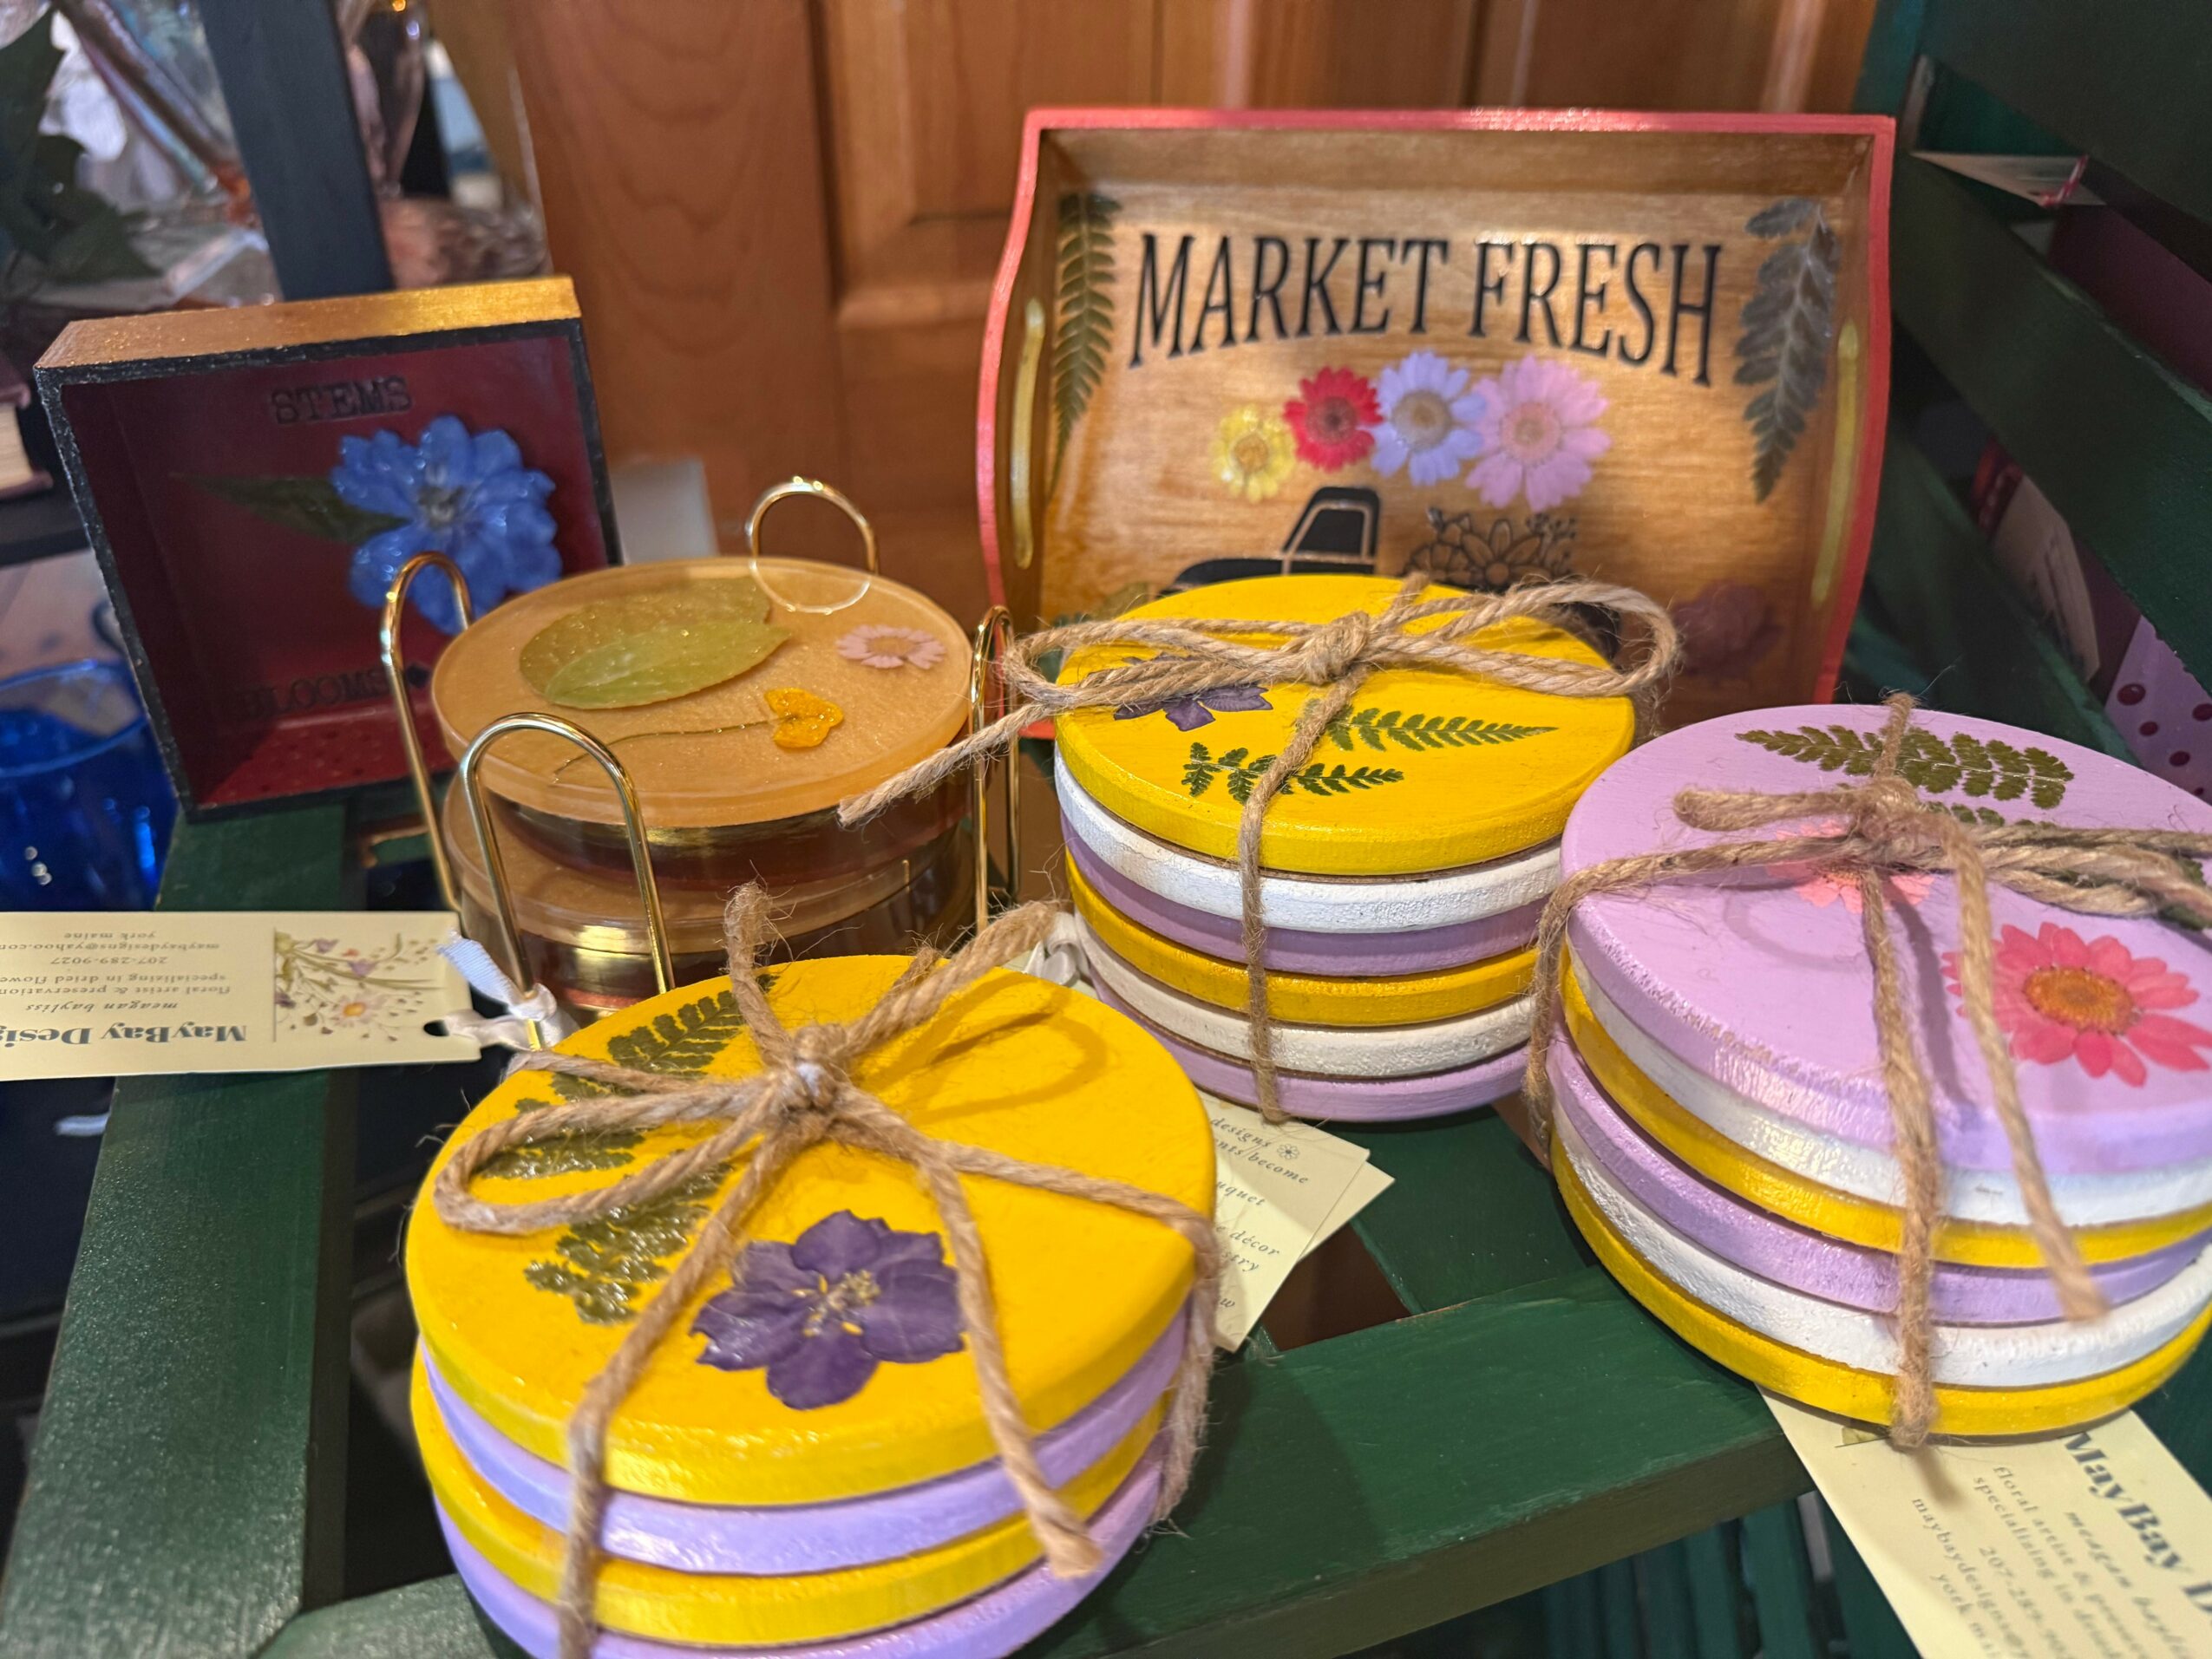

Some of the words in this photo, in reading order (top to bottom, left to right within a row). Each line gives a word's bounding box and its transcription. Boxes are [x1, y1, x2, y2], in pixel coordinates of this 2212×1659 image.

[1128, 231, 1449, 369] MARKET
[1469, 241, 1722, 386] FRESH
[271, 376, 410, 424] STEMS
[120, 931, 155, 940] york
[50, 957, 168, 965] 207-289-9027
[128, 973, 226, 983] specializing
[186, 986, 230, 995] floral
[25, 1001, 95, 1013] bayliss
[103, 1000, 178, 1011] meagan
[101, 1022, 247, 1043] MayBay
[1210, 1118, 1272, 1147] designs
[1216, 1138, 1245, 1156] nts
[1248, 1153, 1308, 1183] become
[1216, 1181, 1265, 1205] uquet
[1229, 1231, 1279, 1256] décor
[1221, 1251, 1259, 1272] stry
[1993, 1466, 2039, 1512] floral
[2064, 1433, 2194, 1572] MayBay
[1973, 1476, 2056, 1581] specializing
